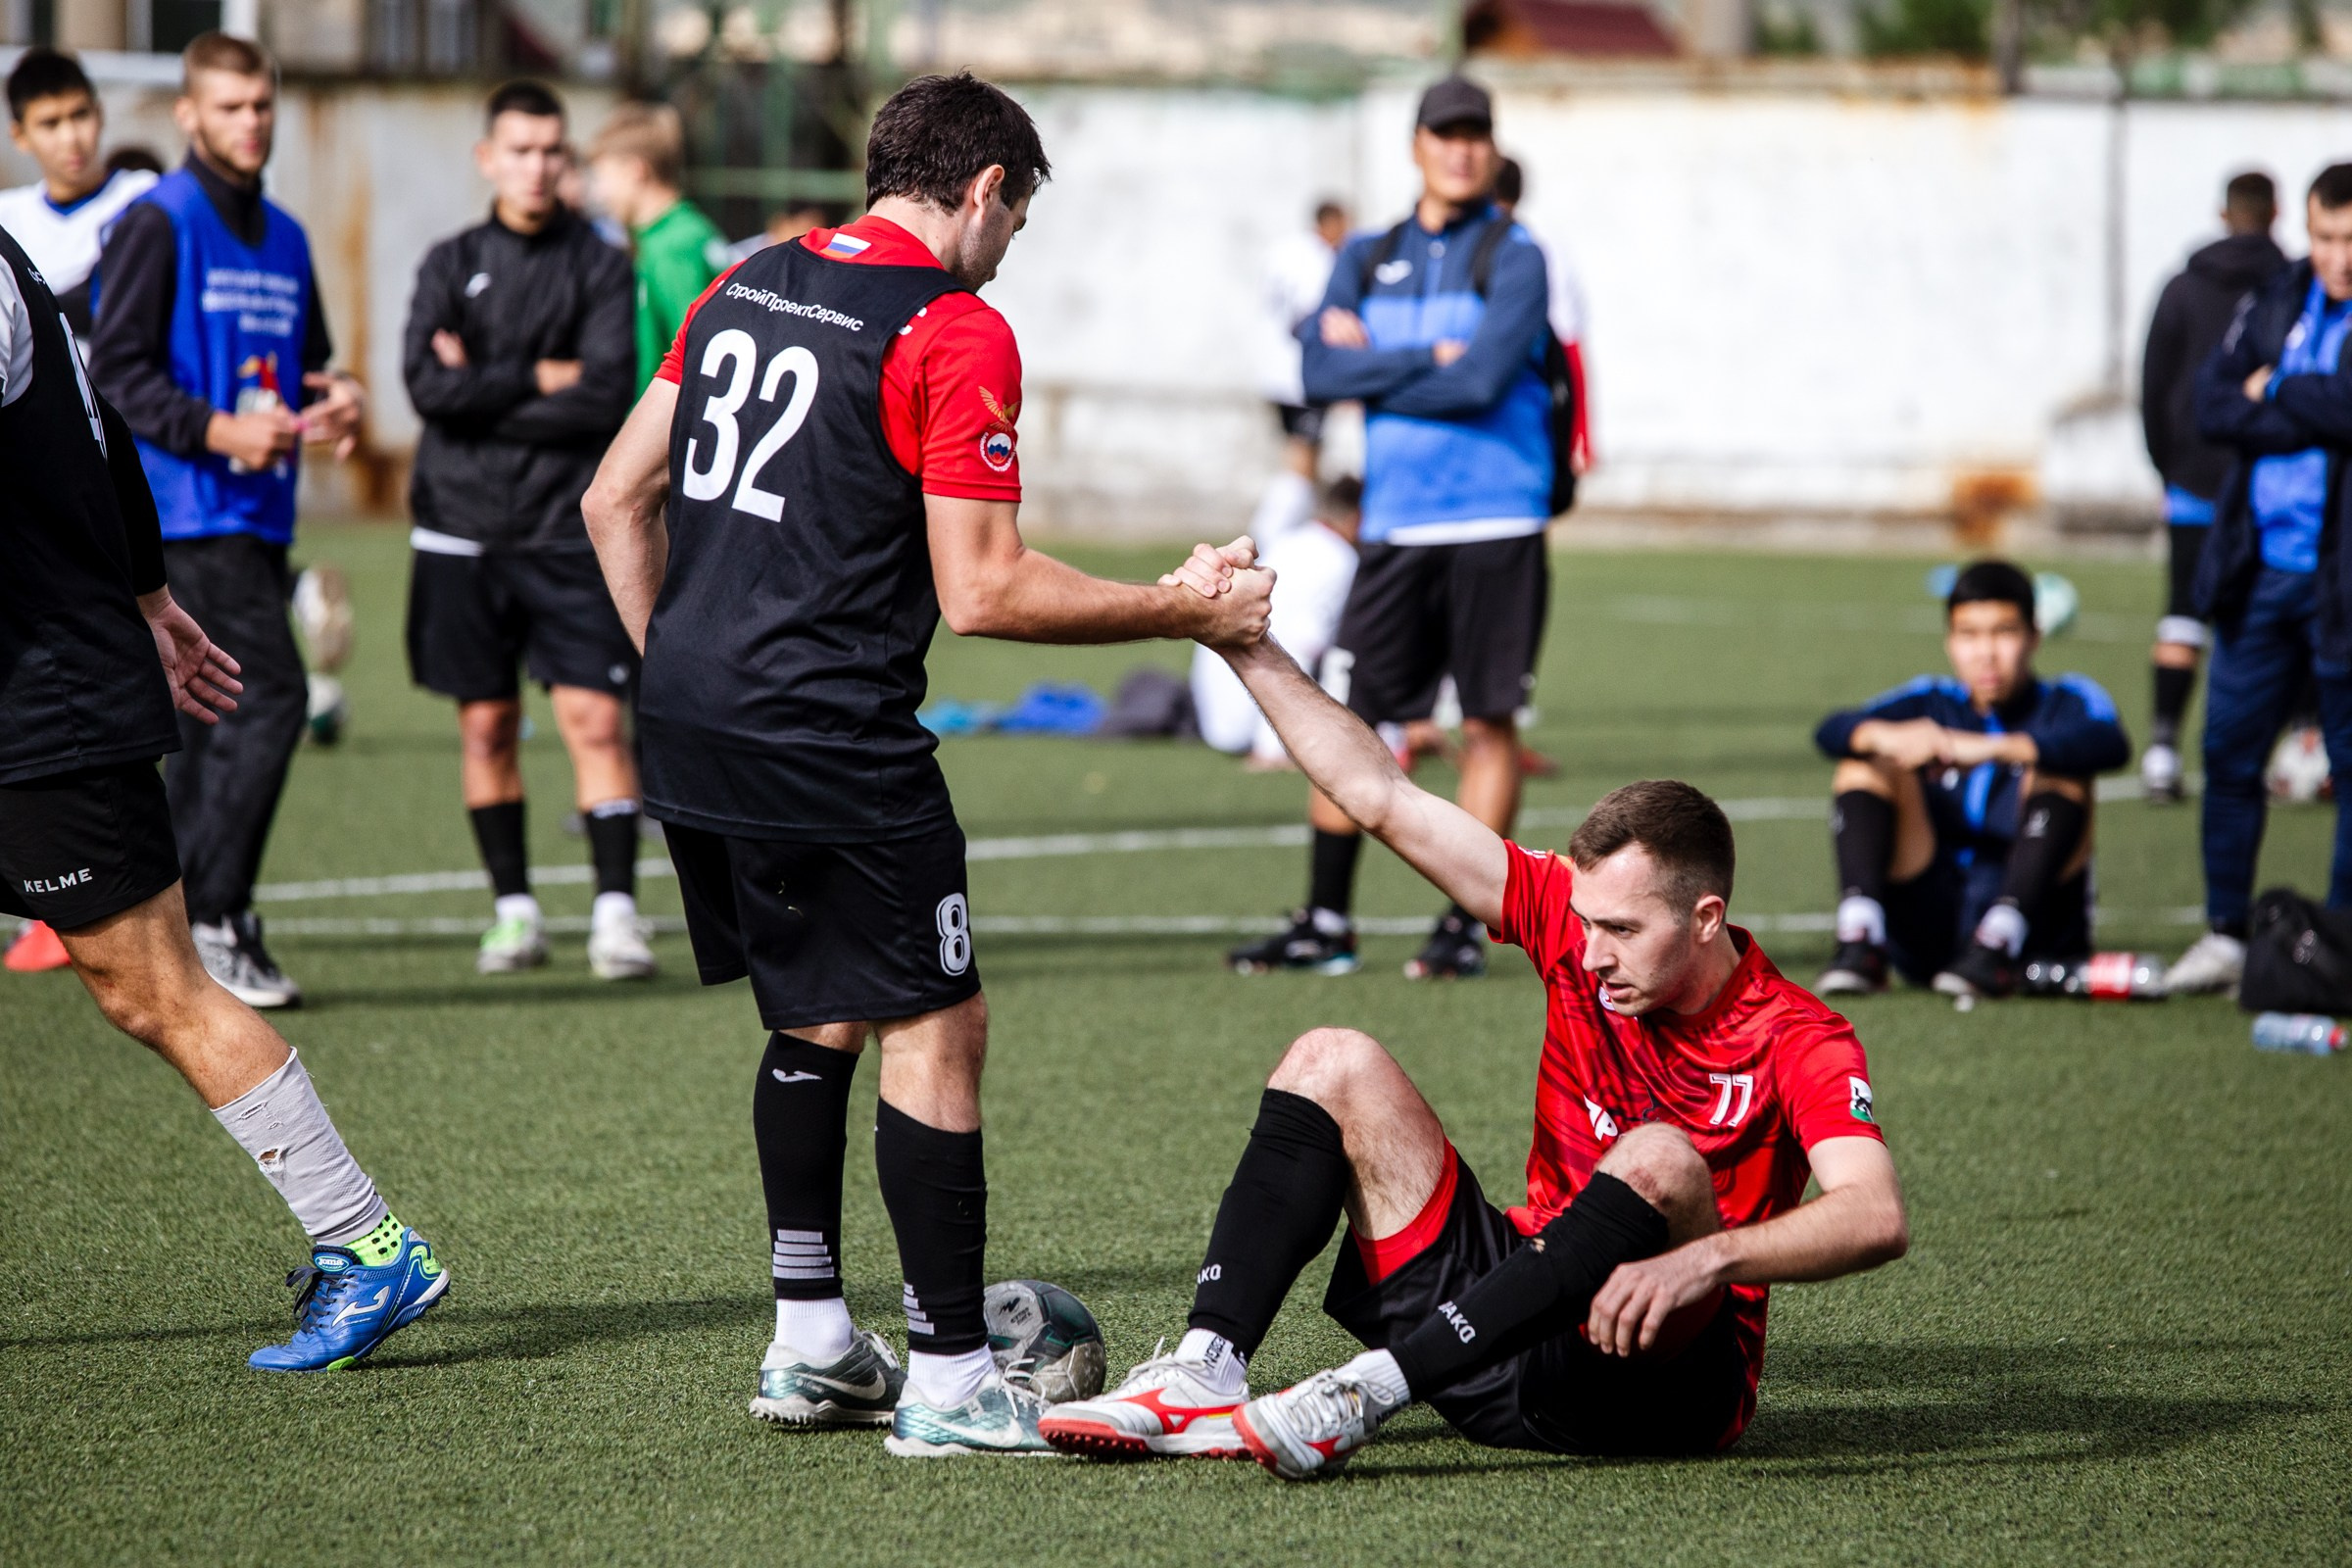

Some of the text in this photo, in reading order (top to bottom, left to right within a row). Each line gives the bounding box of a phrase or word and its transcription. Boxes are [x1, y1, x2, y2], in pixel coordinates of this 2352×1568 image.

[726, 282, 864, 332] СтройПроектСервис
[683, 328, 819, 523] 32
[24, 868, 93, 893] KELME
[936, 892, 971, 976] 8
[1709, 1073, 1754, 1127] 77
